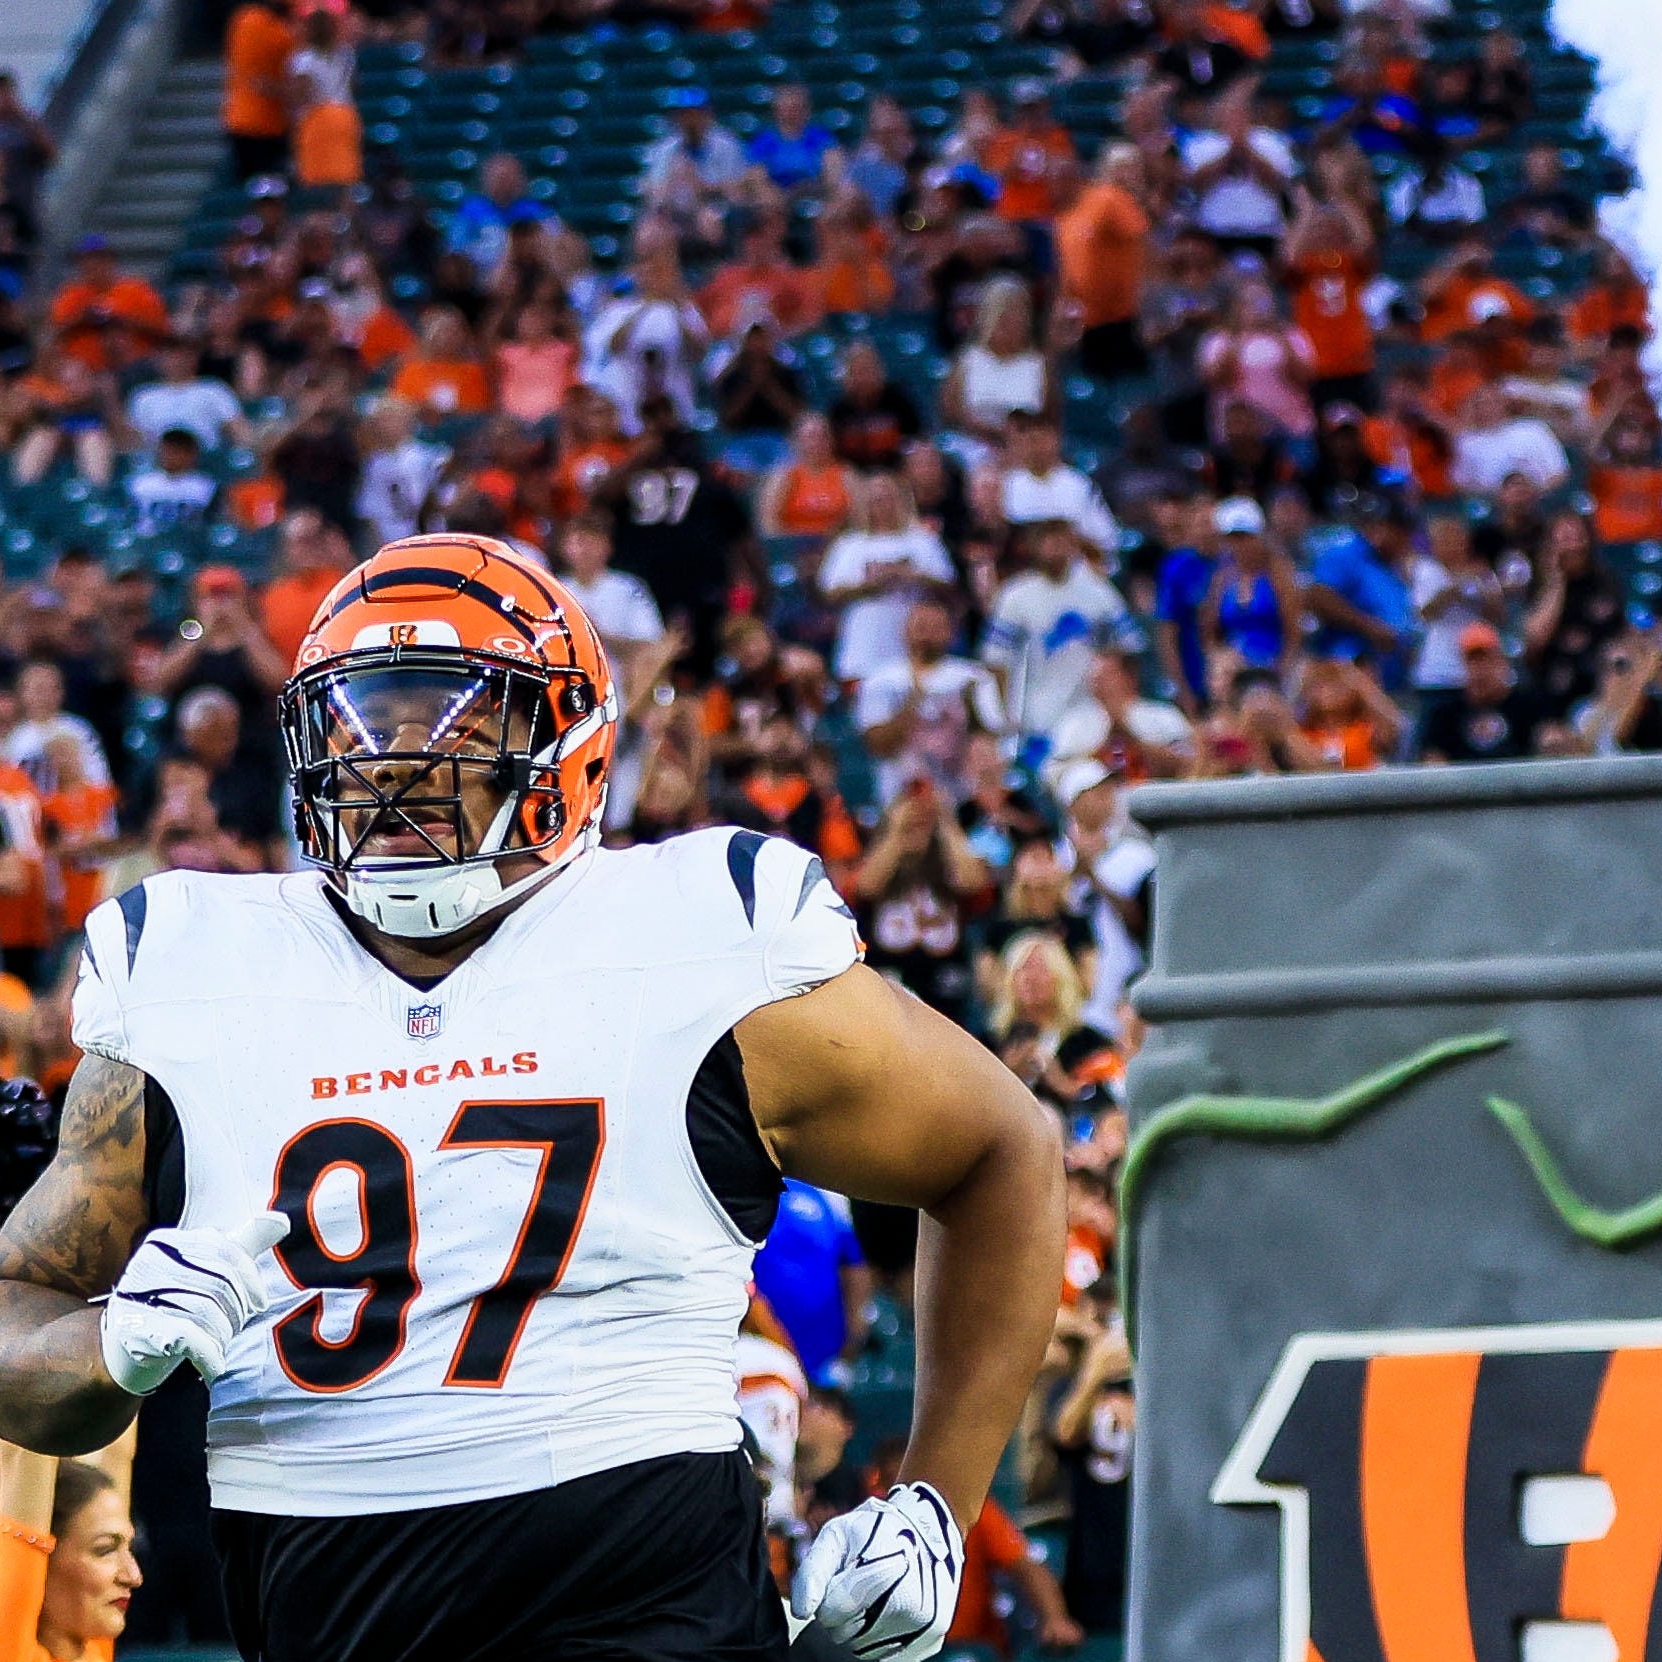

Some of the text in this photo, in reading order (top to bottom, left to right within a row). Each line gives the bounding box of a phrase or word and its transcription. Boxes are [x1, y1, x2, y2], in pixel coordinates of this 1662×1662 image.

[410, 1017, 438, 1036] NFL
[311, 1051, 539, 1100] BENGALS
[271, 1097, 607, 1394] 97
